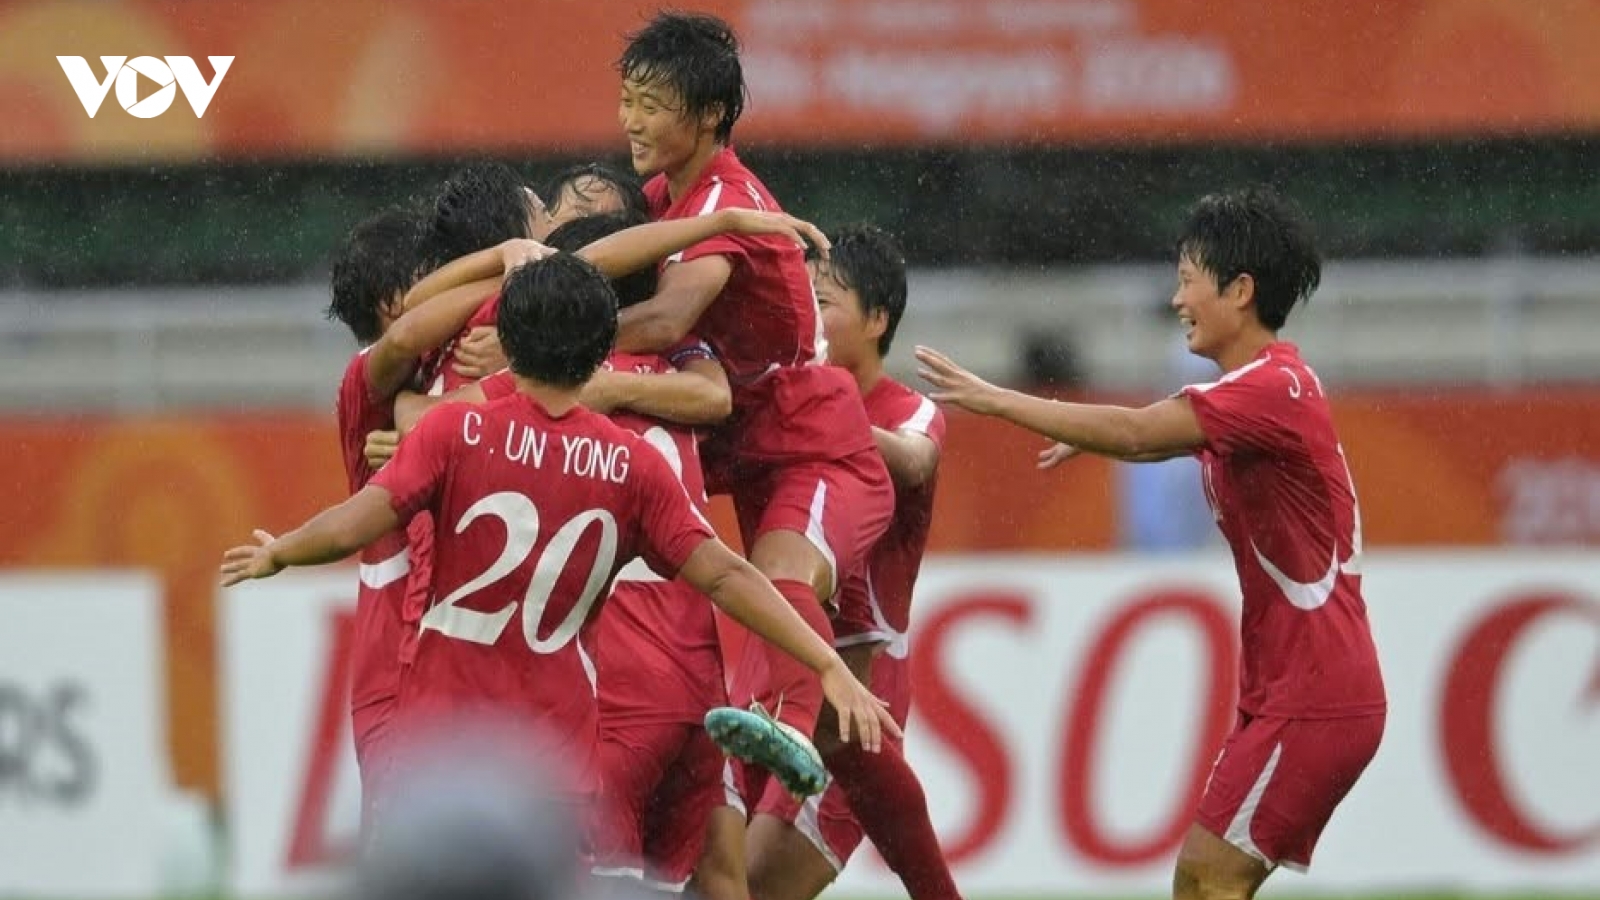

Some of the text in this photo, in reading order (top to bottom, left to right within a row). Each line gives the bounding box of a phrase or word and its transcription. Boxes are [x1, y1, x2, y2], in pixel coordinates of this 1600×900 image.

[505, 420, 547, 469] UN
[561, 435, 630, 483] YONG
[418, 490, 618, 654] 20
